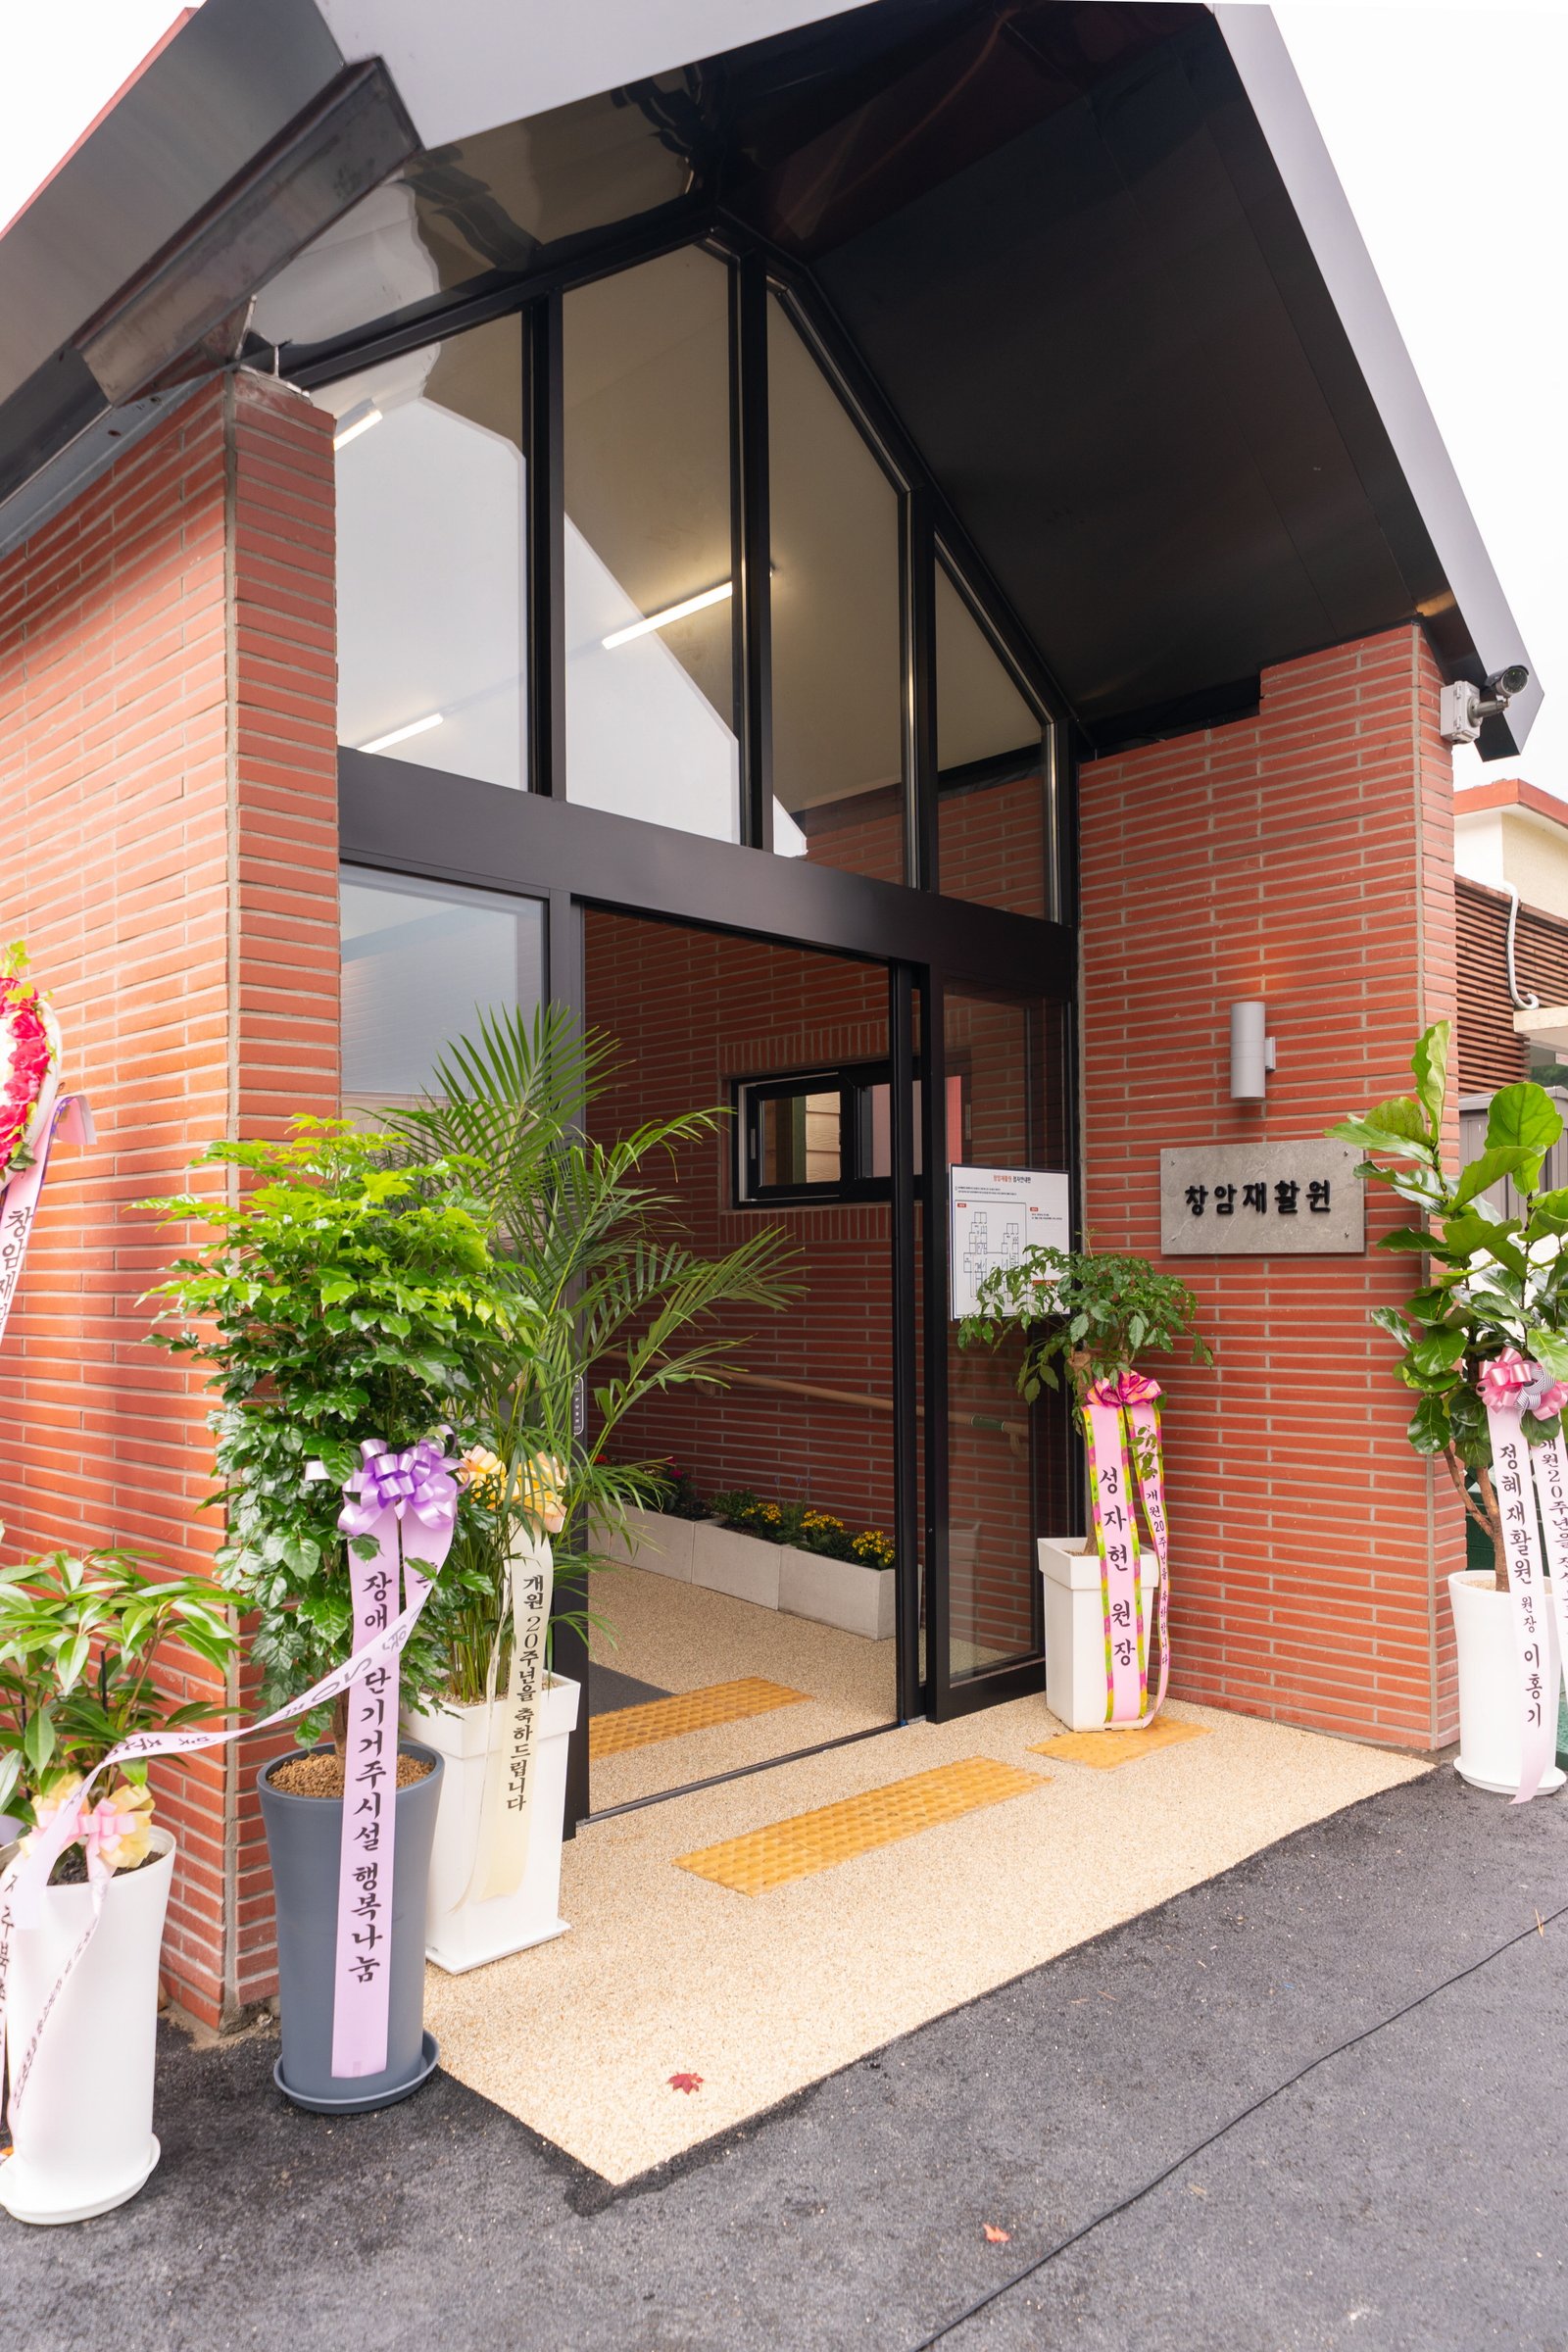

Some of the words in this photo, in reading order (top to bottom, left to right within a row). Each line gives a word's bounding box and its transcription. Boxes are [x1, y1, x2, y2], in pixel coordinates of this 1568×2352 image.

[1185, 1180, 1331, 1215] 창암재활원
[1099, 1466, 1127, 1572] 성자현
[1500, 1444, 1532, 1585] 정혜재활원
[523, 1574, 544, 1610] 개원
[1111, 1599, 1136, 1666] 원장
[1521, 1596, 1537, 1633] 원장
[516, 1615, 541, 1702] 20주년을
[1524, 1643, 1544, 1728] 이홍기
[354, 1572, 393, 1851] 장애단기거주시설
[507, 1707, 535, 1812] 축하드립니다
[348, 1862, 383, 1984] 행복나눔
